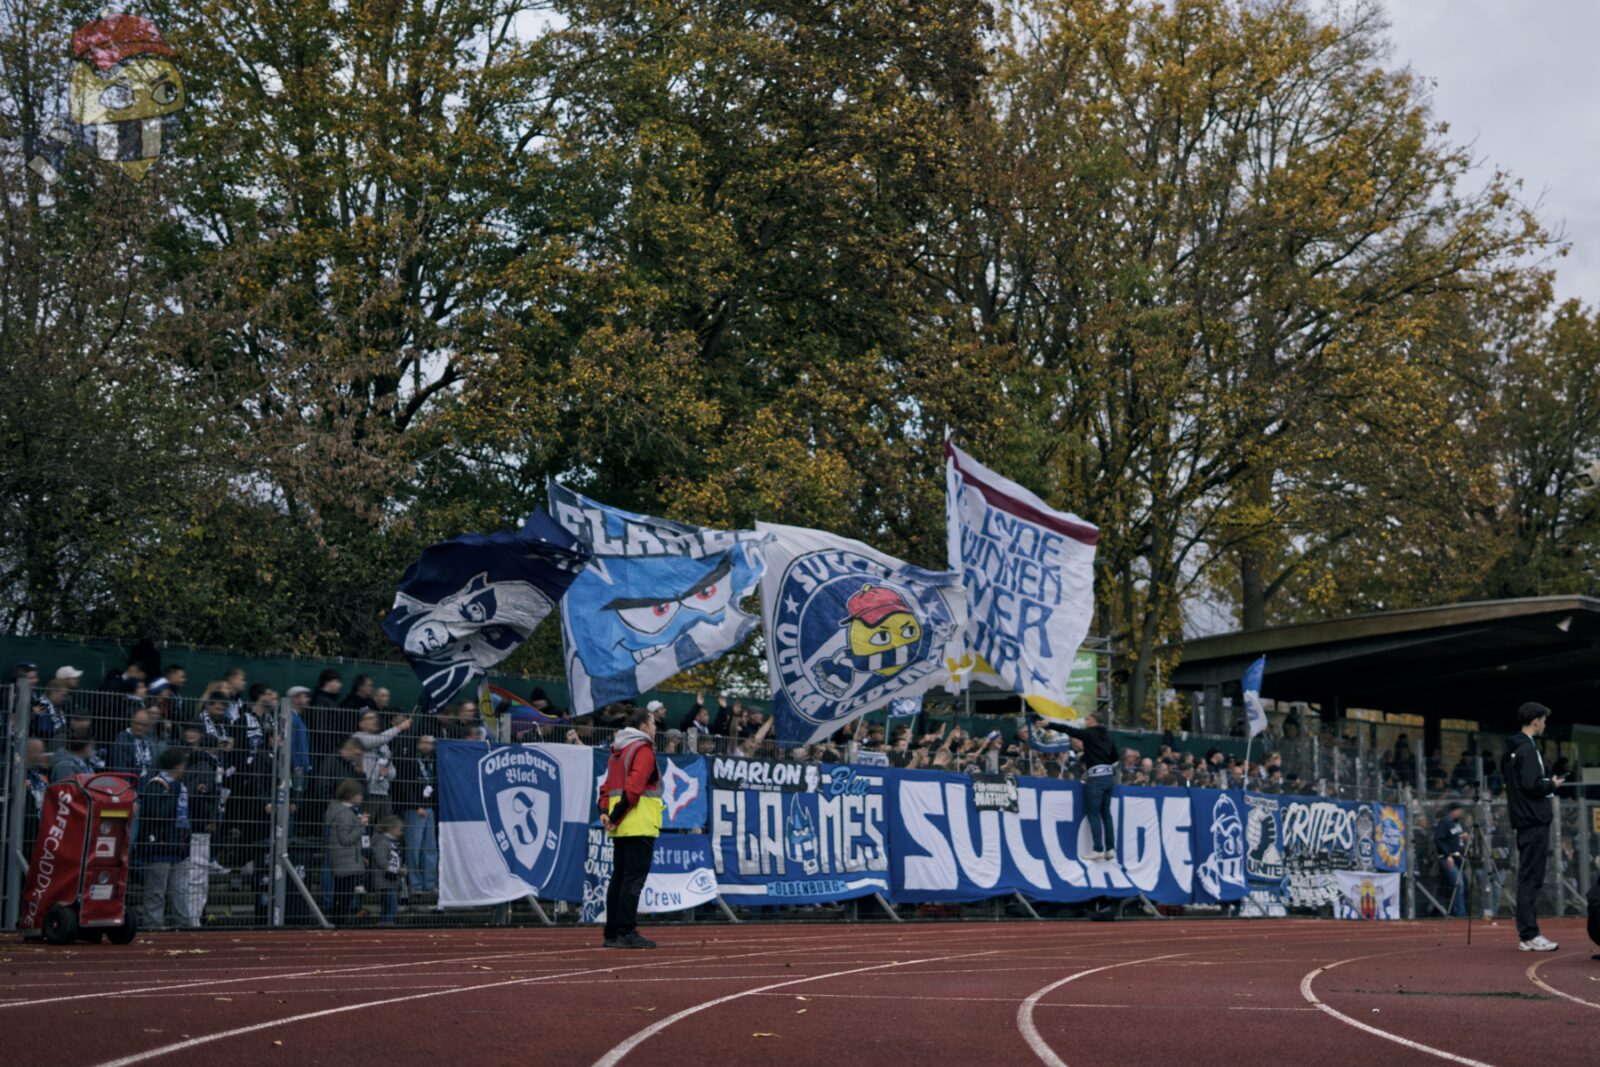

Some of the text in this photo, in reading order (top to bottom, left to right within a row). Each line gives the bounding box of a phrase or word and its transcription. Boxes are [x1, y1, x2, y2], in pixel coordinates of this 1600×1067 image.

[485, 751, 557, 780] Oldenburg
[505, 767, 538, 785] Block
[712, 757, 802, 786] MARLON
[830, 766, 870, 797] Blue
[495, 828, 558, 852] 20 07
[711, 788, 888, 876] FLAMES
[1282, 801, 1358, 853] CRITTERS
[644, 886, 682, 907] Crew
